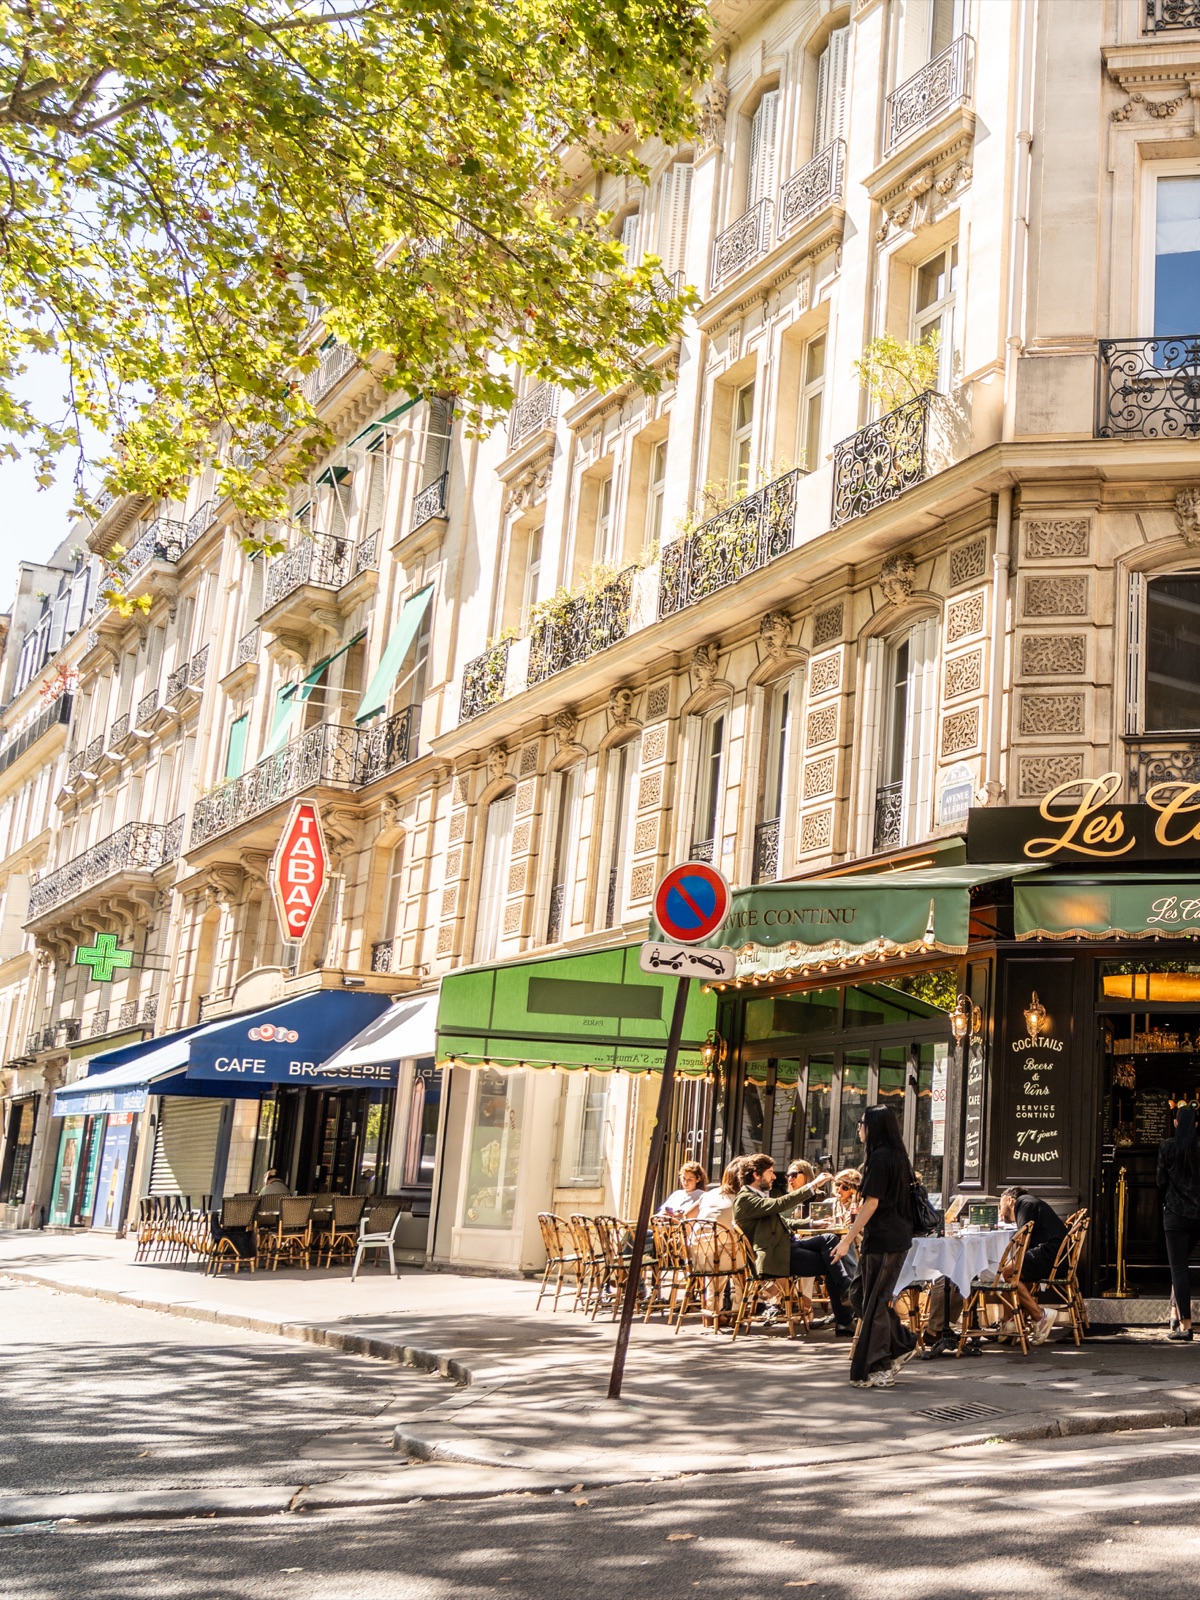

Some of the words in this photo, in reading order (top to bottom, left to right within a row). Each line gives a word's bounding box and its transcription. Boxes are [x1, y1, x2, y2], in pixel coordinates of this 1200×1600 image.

[946, 790, 970, 804] AVENUE
[1023, 771, 1136, 858] Les
[286, 816, 317, 928] TABAC
[763, 908, 857, 926] CONTINU
[1146, 896, 1181, 924] Les
[248, 1023, 299, 1043] LOTO
[1012, 1036, 1064, 1052] COCKTAILS
[214, 1057, 267, 1074] CAFE
[1023, 1058, 1054, 1071] Beers
[1032, 1073, 1040, 1081] &
[1023, 1082, 1051, 1096] Vins
[968, 1095, 981, 1105] CAFE
[1016, 1129, 1039, 1147] 7/7
[1037, 1130, 1058, 1144] jours
[1013, 1150, 1059, 1162] BRUNCH
